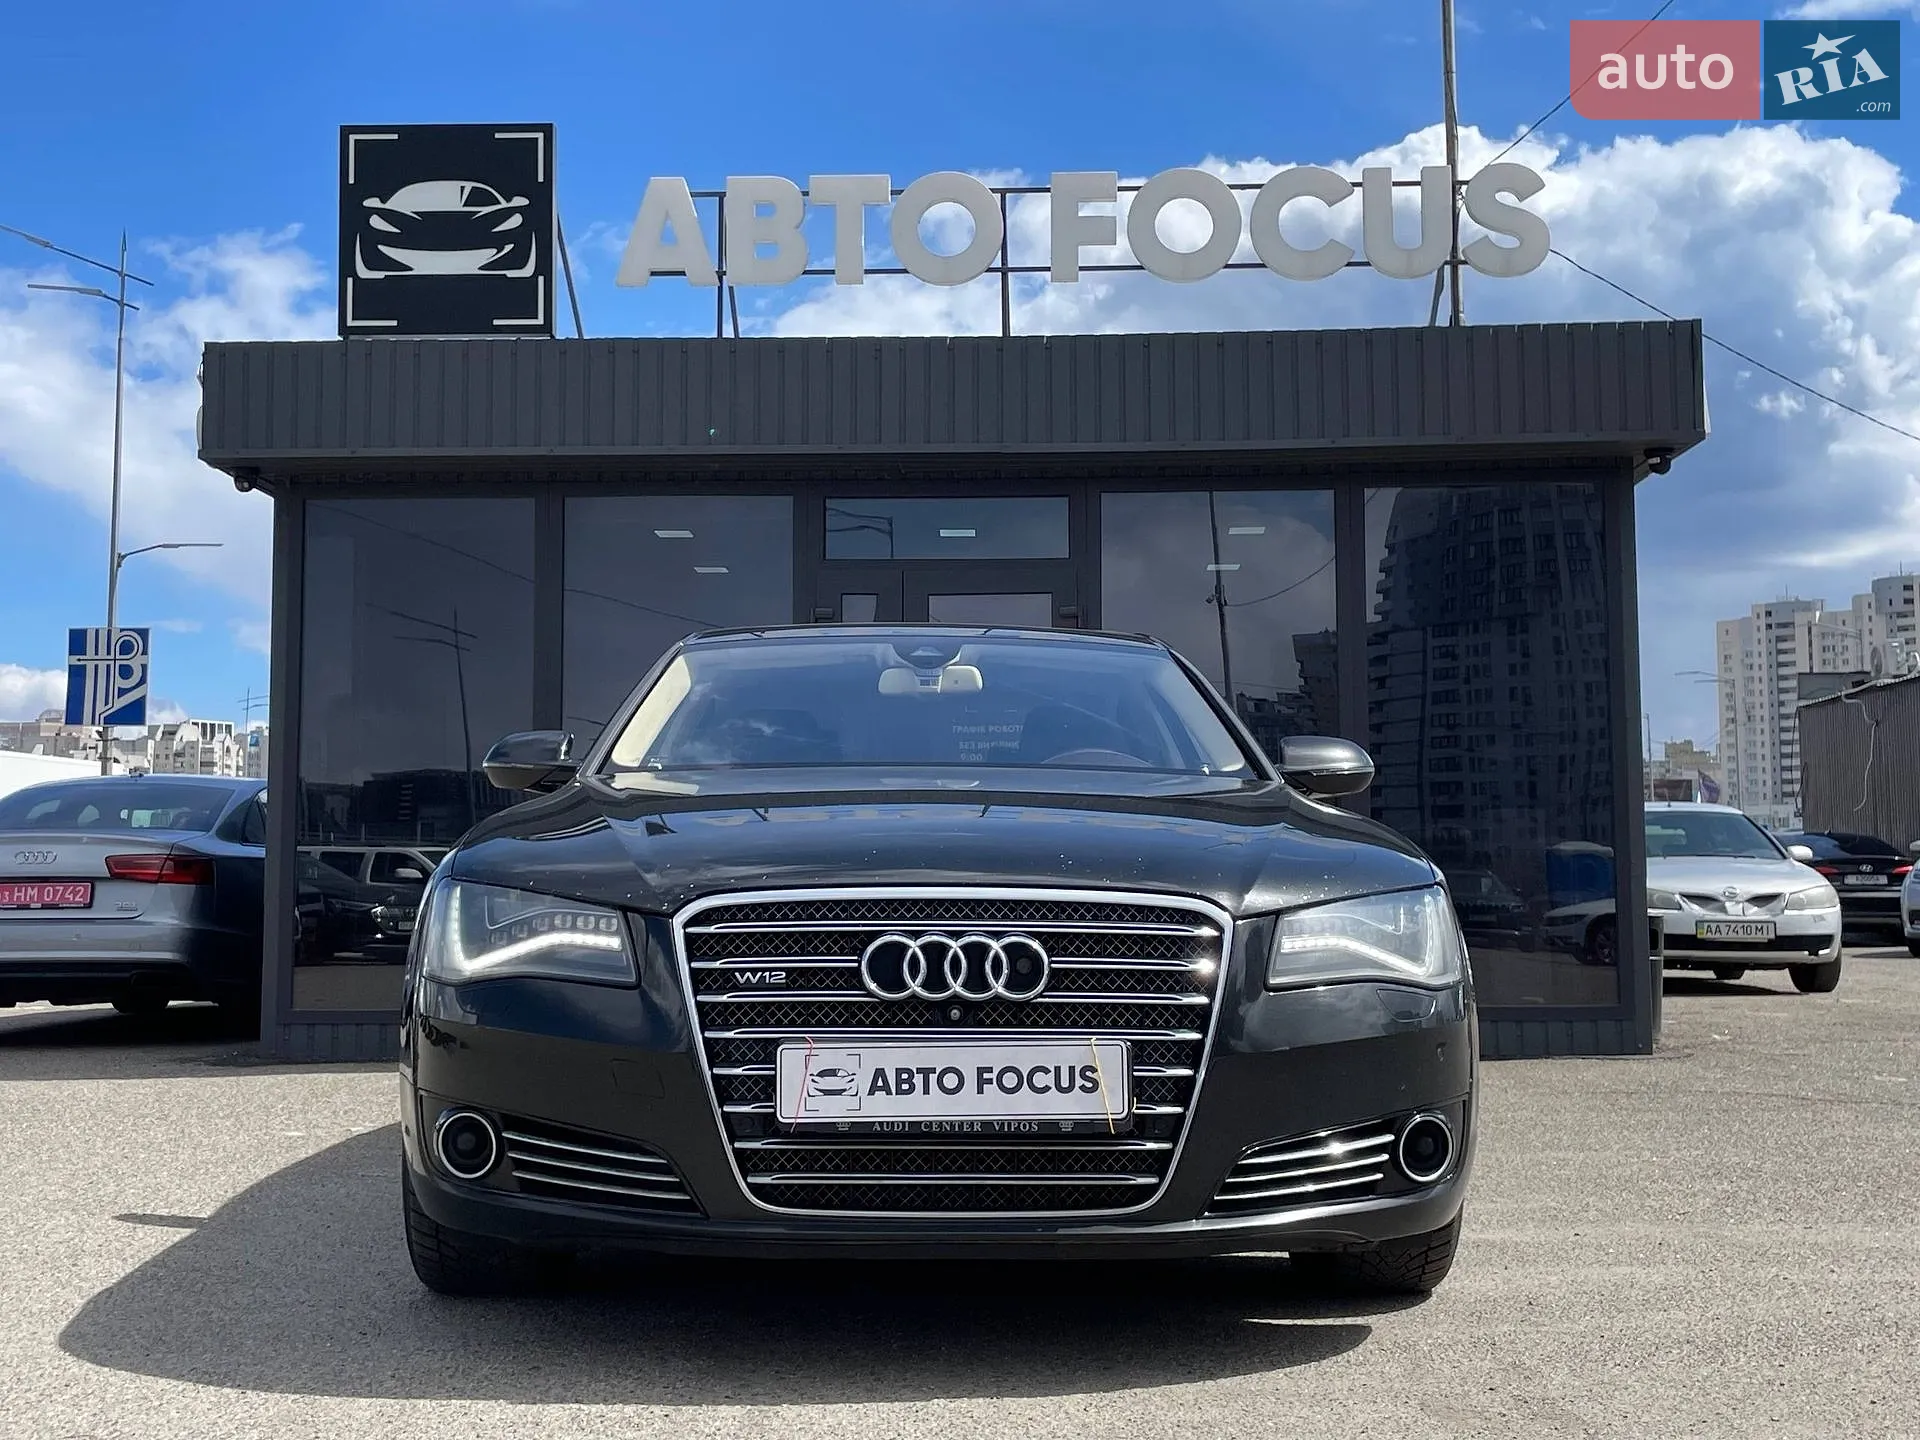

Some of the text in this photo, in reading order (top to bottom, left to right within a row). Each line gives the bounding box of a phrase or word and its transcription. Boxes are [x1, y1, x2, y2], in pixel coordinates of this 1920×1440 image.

[616, 163, 1551, 287] АВТО FOCUS
[44, 886, 85, 902] 0742
[1705, 924, 1723, 936] AA
[1725, 924, 1753, 936] 7410
[734, 971, 787, 984] W12
[867, 1065, 1100, 1096] АВТО FOCUS
[872, 1120, 1039, 1132] AUDI CENTER VIPOS
